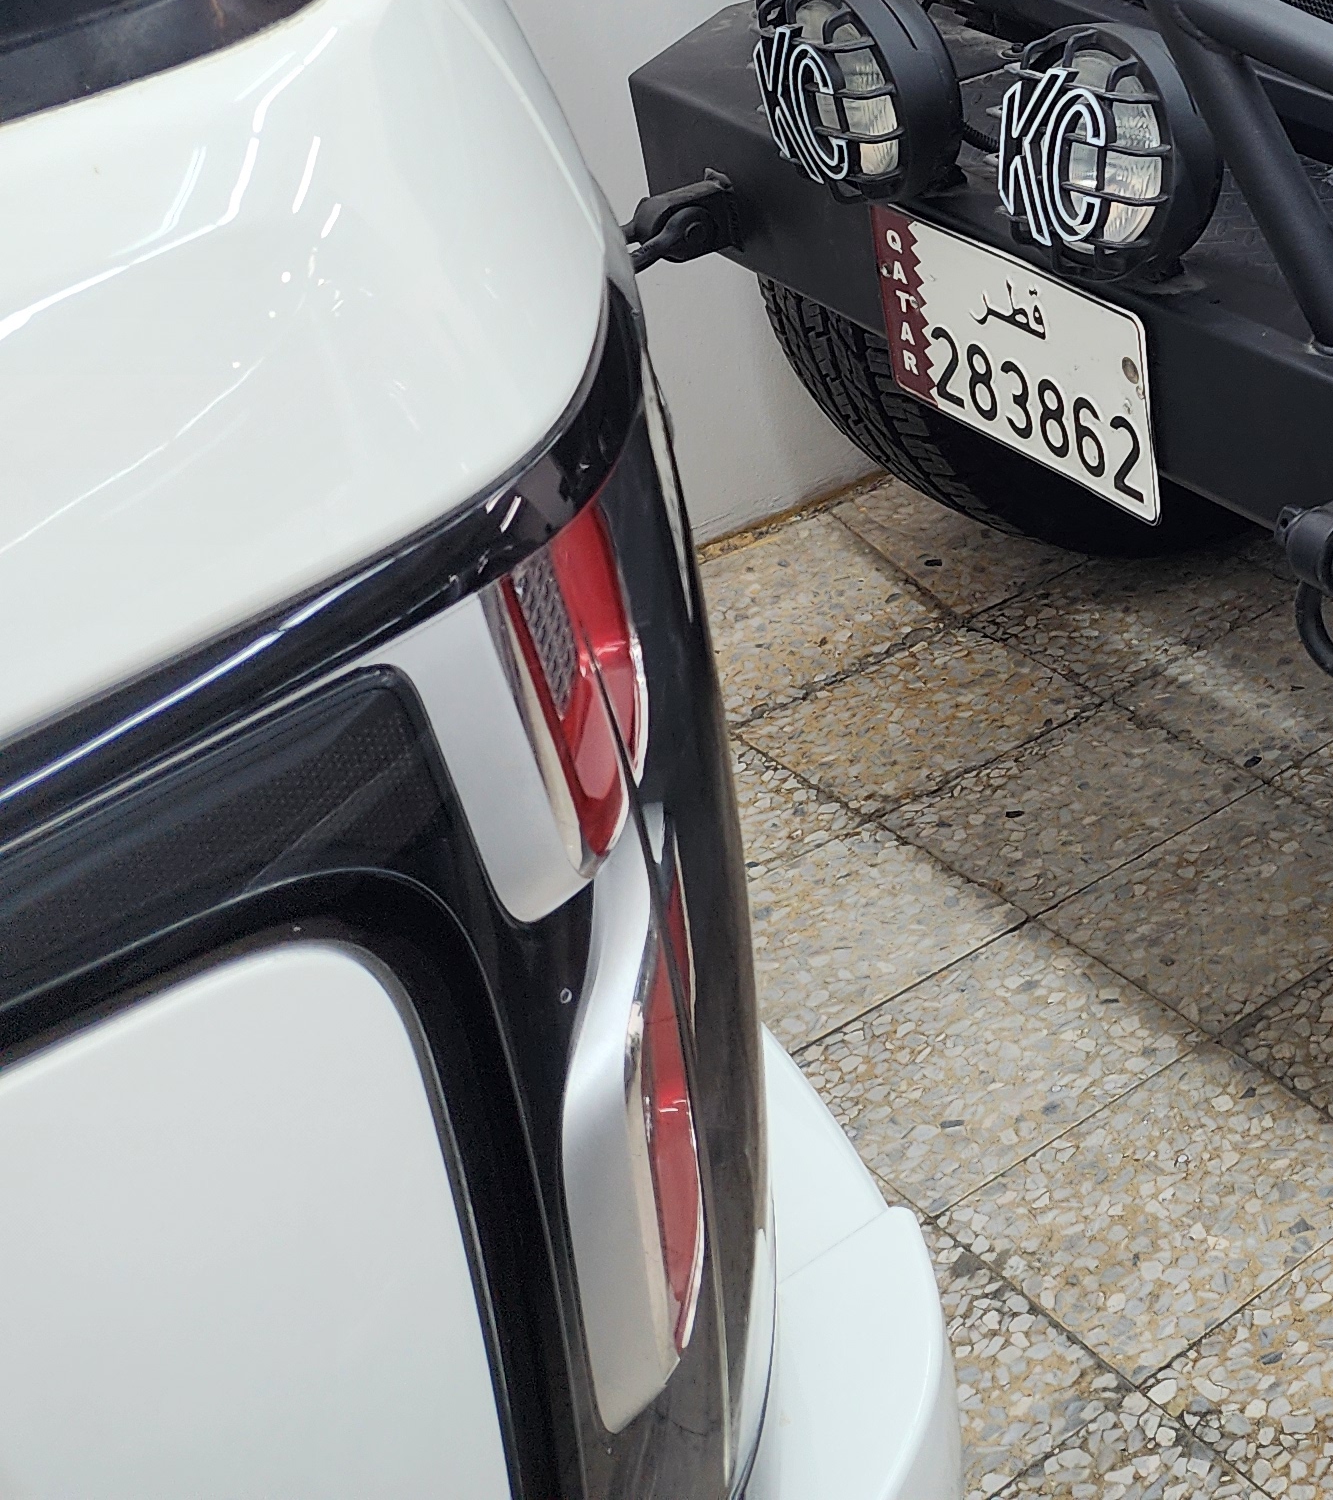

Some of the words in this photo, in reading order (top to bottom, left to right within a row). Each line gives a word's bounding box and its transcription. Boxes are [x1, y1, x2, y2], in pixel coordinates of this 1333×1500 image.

[753, 27, 849, 184] KC
[998, 67, 1107, 247] KC
[885, 229, 920, 377] QATAR
[968, 279, 1047, 341] قطر
[930, 326, 1146, 504] 283862
